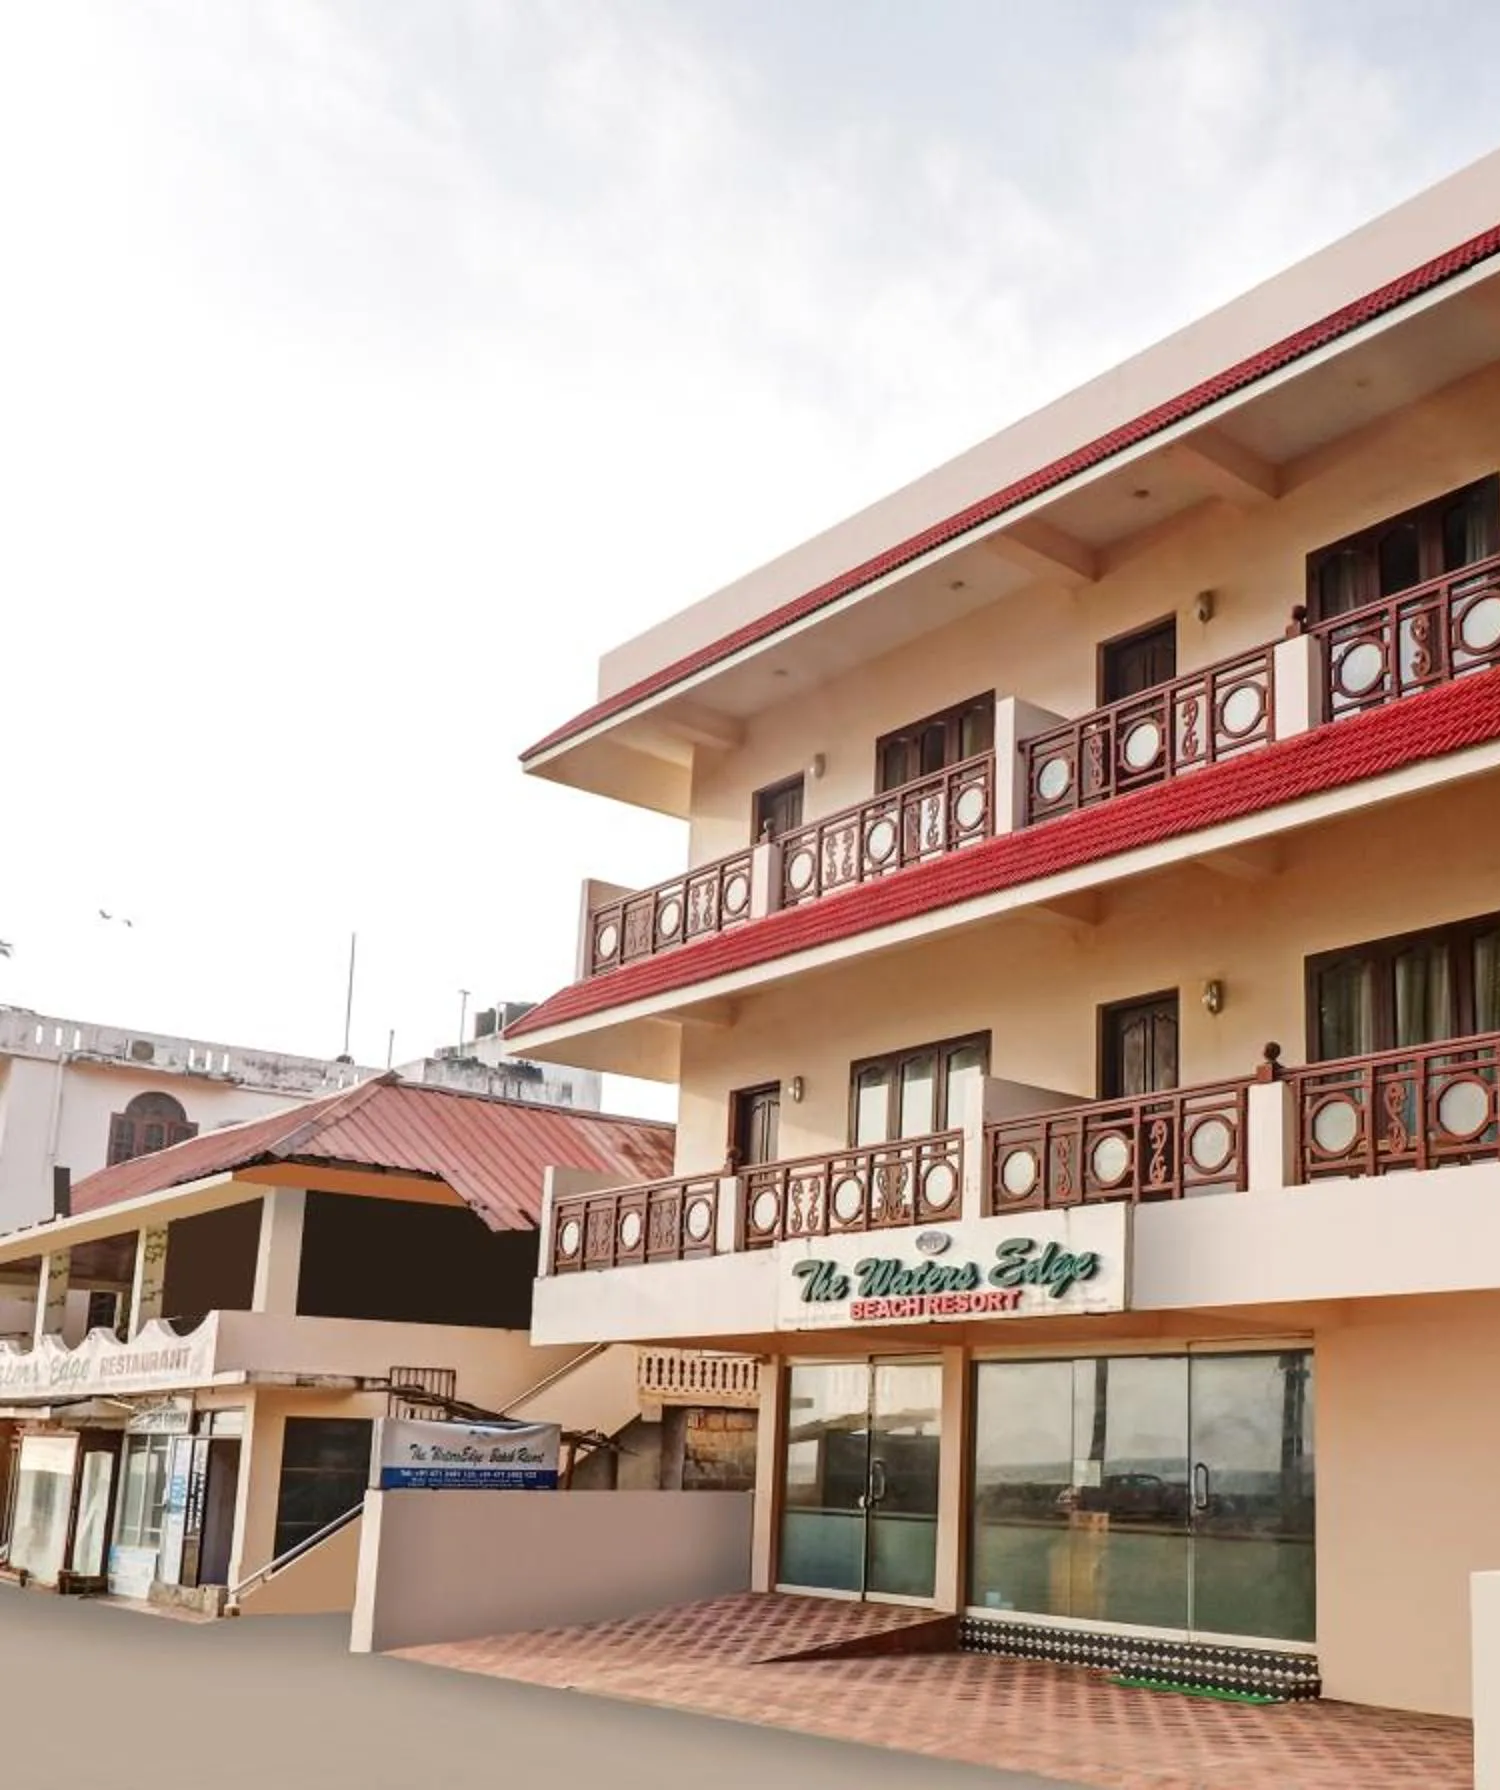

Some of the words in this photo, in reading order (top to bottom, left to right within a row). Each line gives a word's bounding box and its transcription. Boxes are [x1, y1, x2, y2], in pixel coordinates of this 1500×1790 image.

[792, 1259, 850, 1302] The
[854, 1257, 980, 1298] Waters
[988, 1237, 1099, 1299] Edge
[850, 1298, 921, 1320] BEACH
[923, 1289, 1024, 1316] RESORT
[99, 1346, 192, 1378] RESTAURANT
